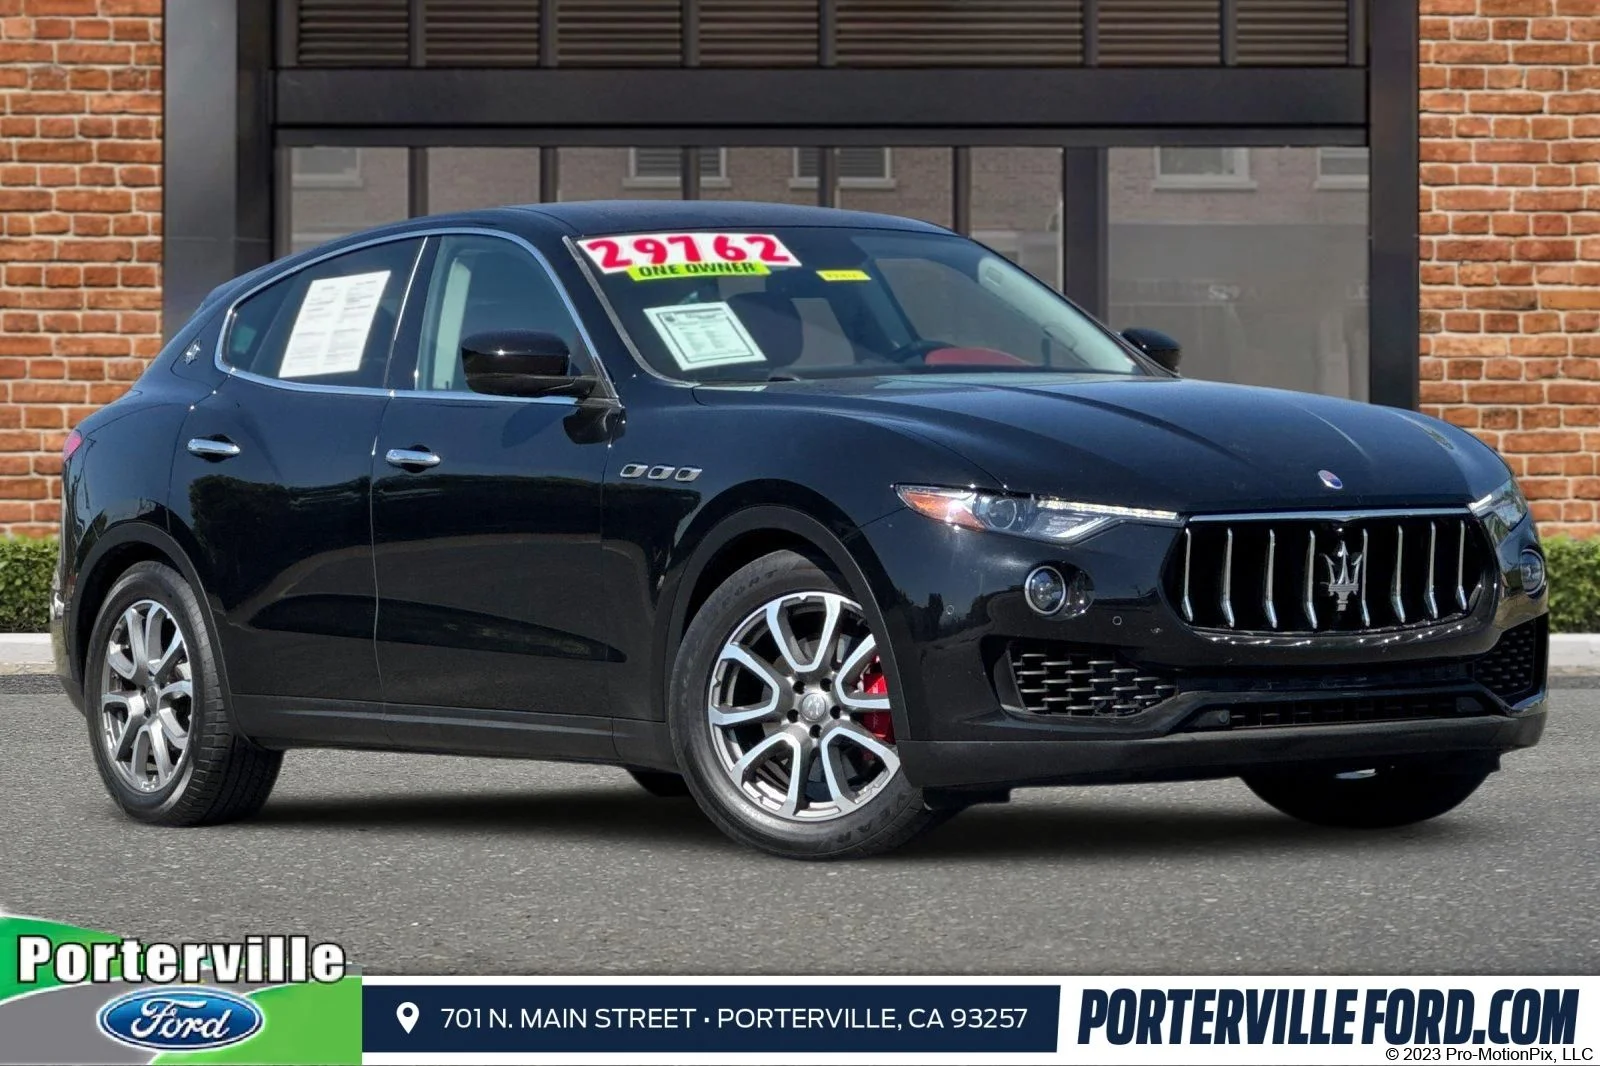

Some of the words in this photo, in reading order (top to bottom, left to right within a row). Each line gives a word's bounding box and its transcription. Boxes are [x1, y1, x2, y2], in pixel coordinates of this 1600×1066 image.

[587, 235, 790, 268] 29762
[638, 263, 678, 277] ONE
[685, 262, 756, 275] OWNER
